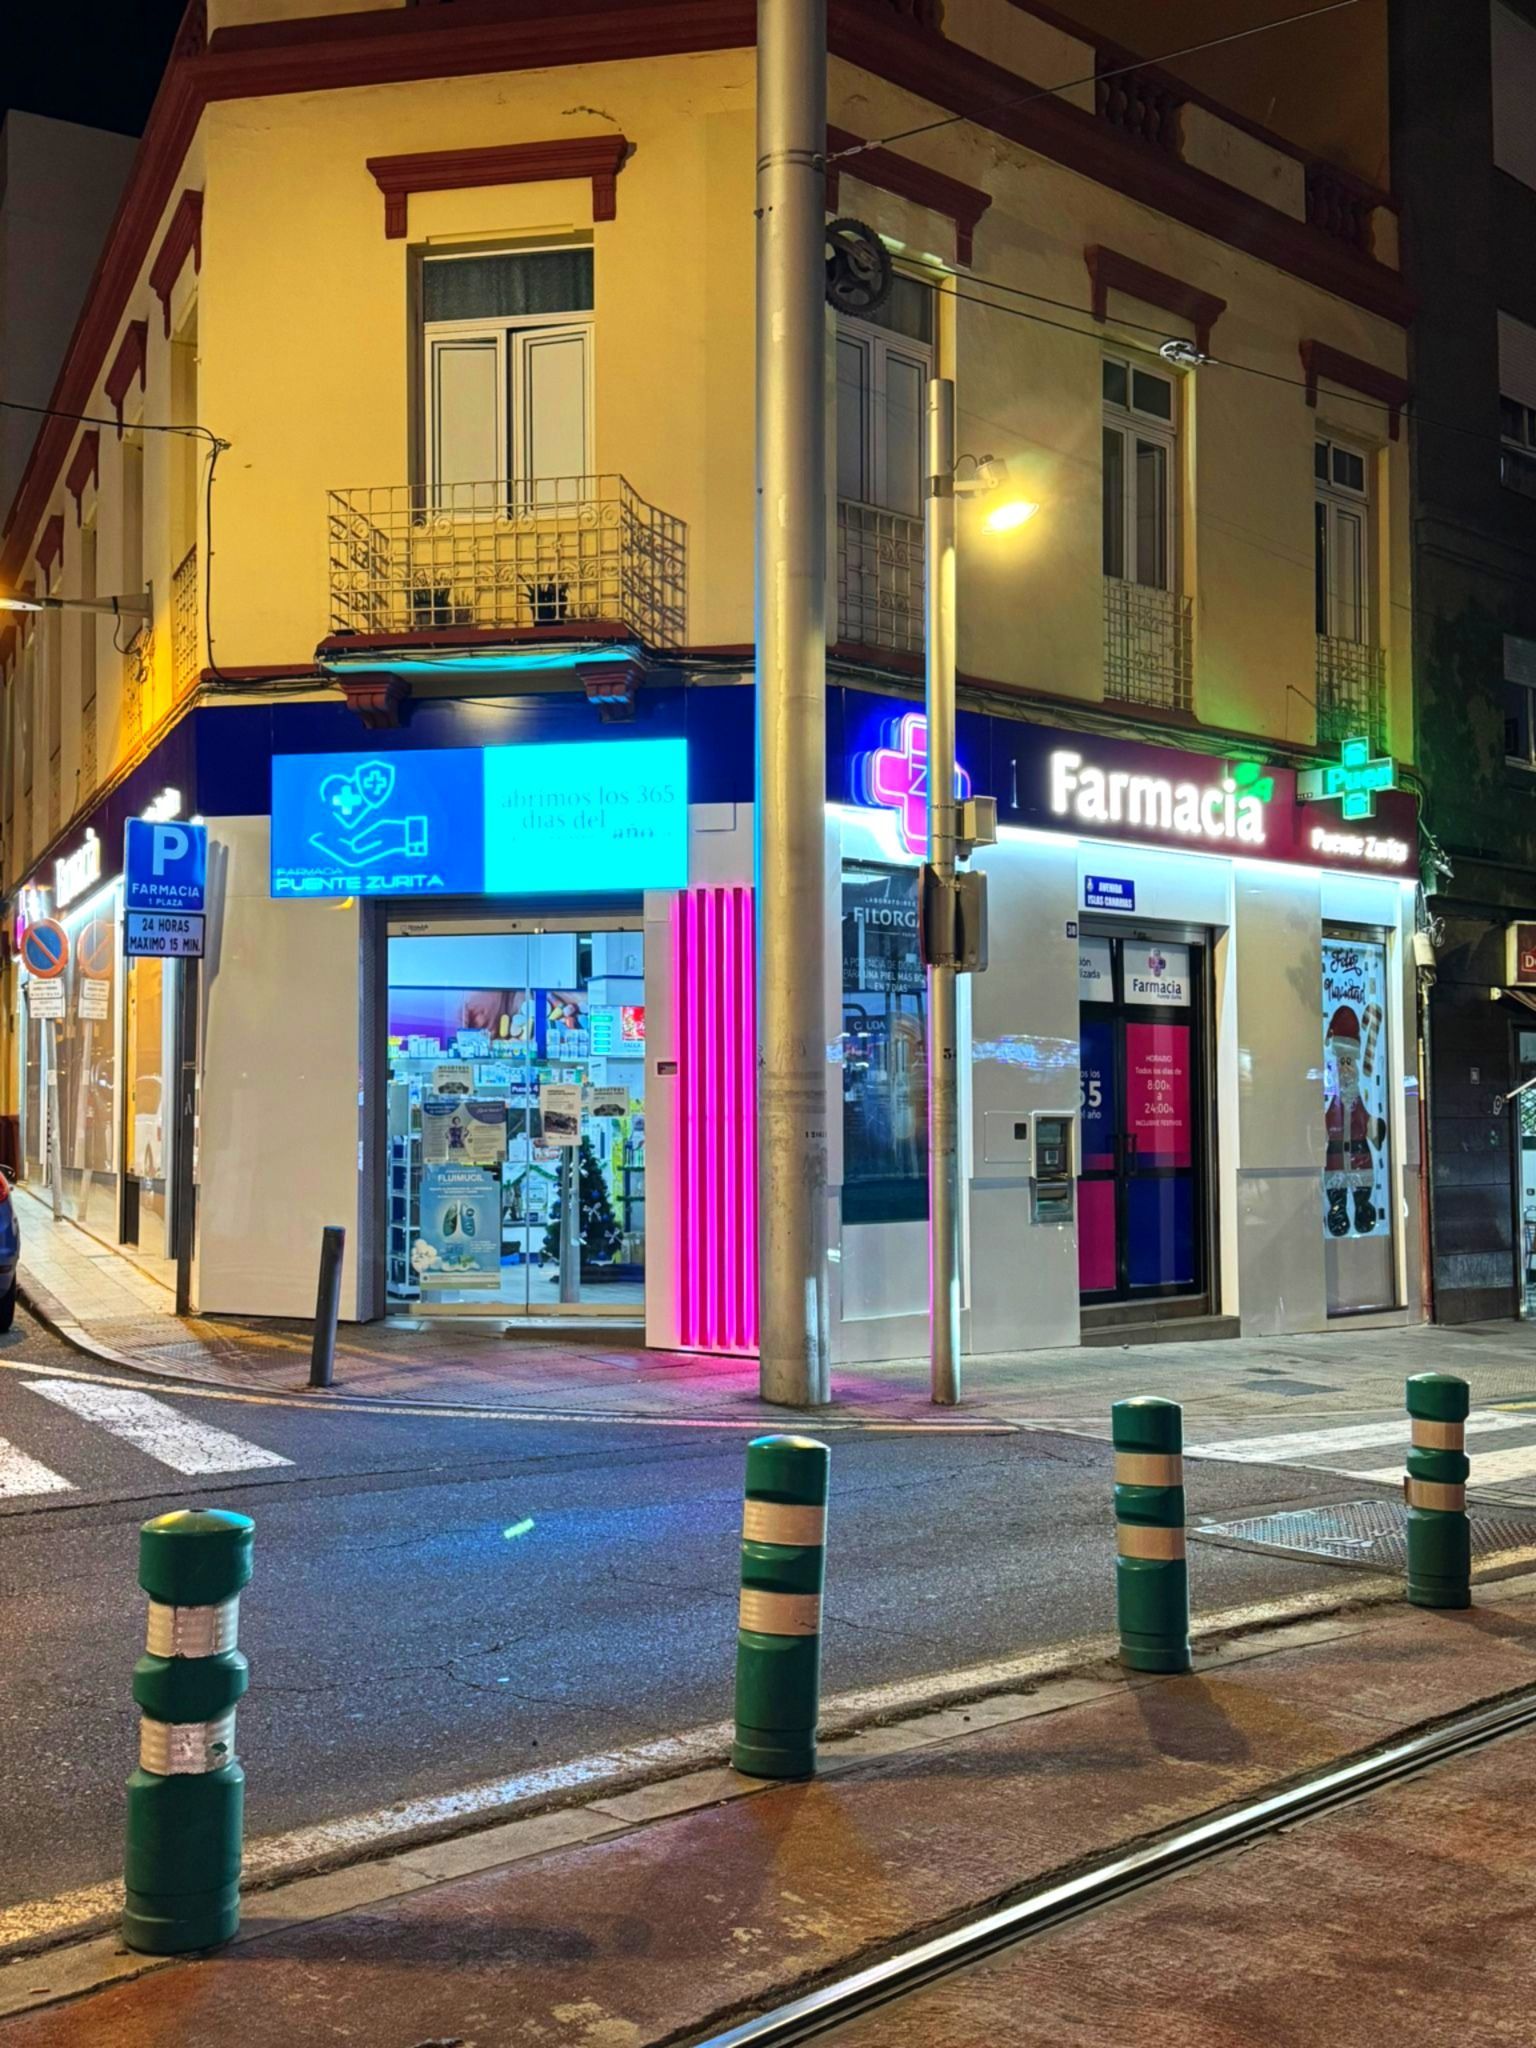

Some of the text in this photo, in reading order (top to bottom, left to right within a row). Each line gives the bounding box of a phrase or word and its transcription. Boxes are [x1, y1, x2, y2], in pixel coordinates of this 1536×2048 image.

[501, 784, 676, 809] abrimos los 365
[1049, 751, 1266, 844] Farmacia
[573, 809, 606, 830] del
[152, 825, 189, 876] P
[131, 882, 200, 898] FARMACIA
[276, 874, 444, 891] PUENTE ZURITA
[155, 898, 184, 907] PLAZA
[142, 917, 190, 933] 24 HORAS
[853, 906, 920, 929] FILORG
[130, 936, 201, 953] MAXIMO 15 MIN.
[1524, 954, 1536, 969] D
[1132, 978, 1182, 995] Farmacia
[1087, 1109, 1102, 1120] año
[437, 1174, 485, 1183] FLUIMUCIL
